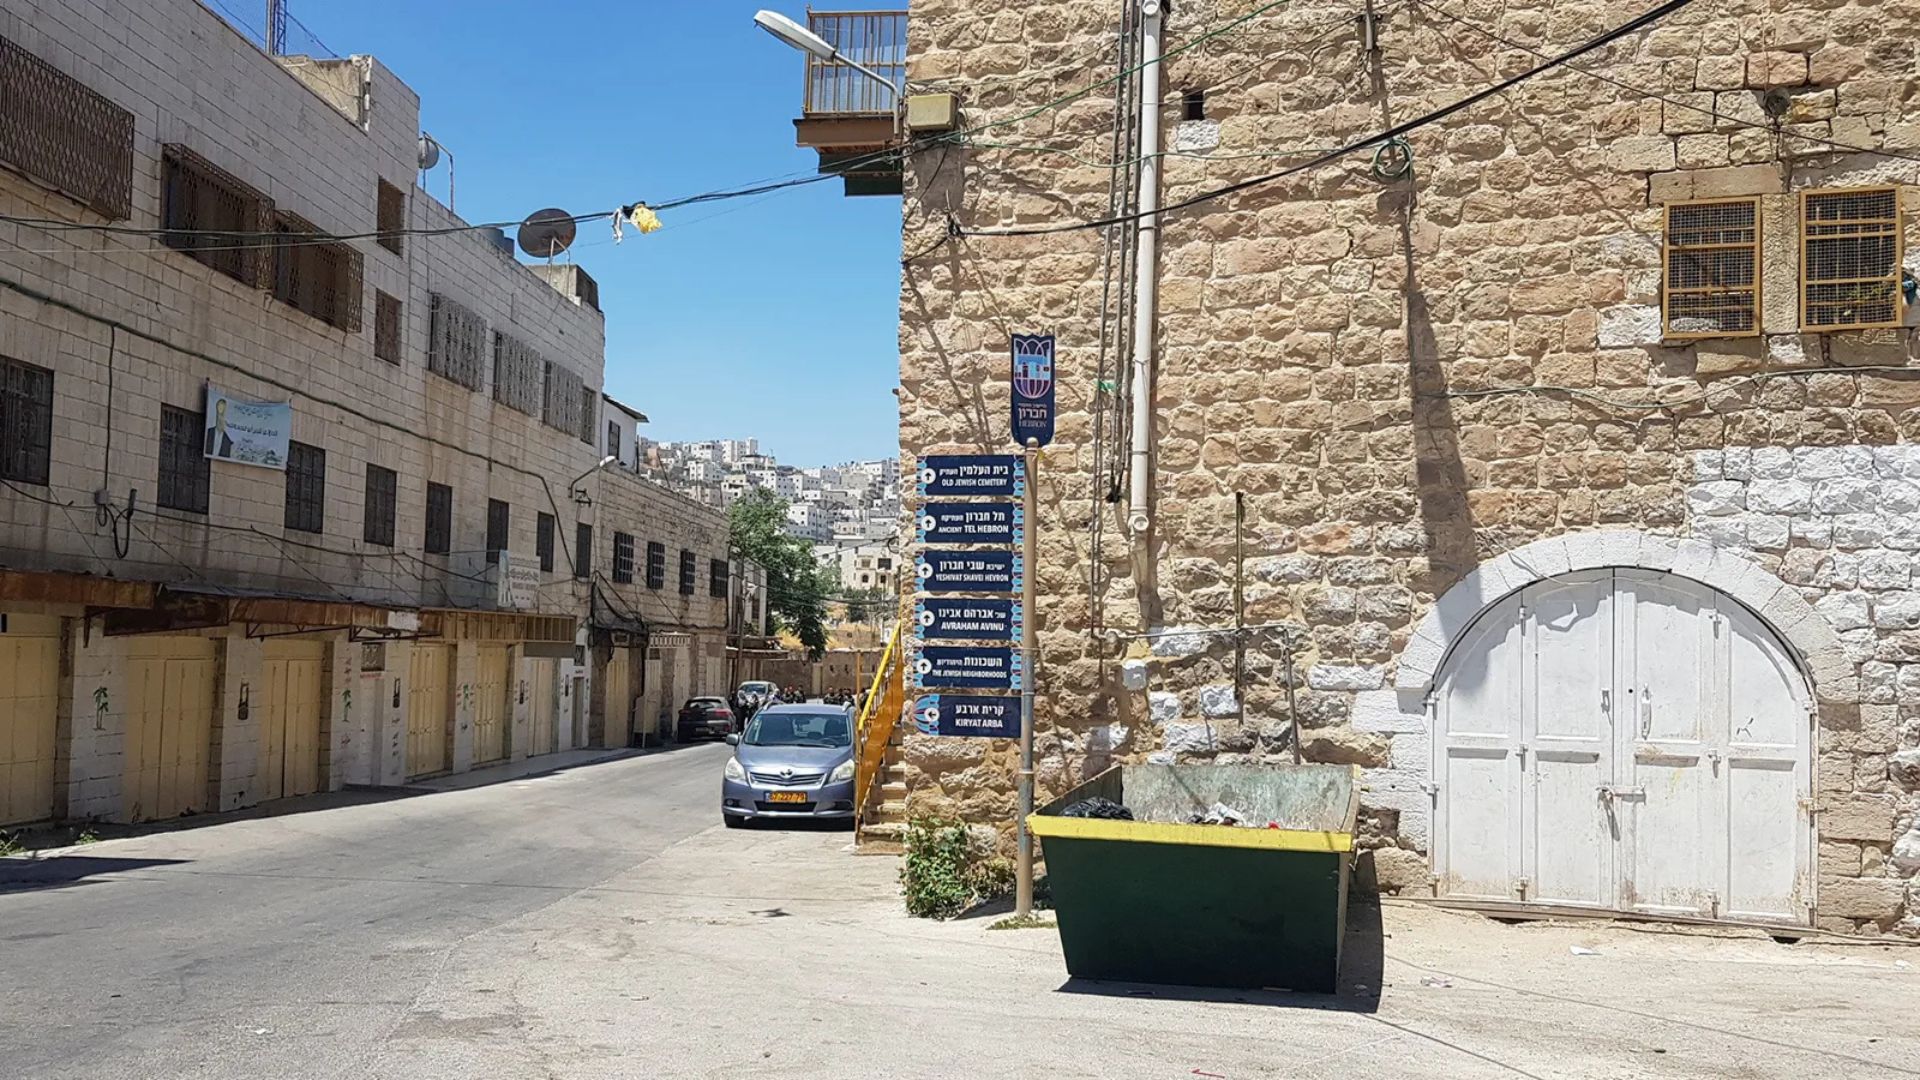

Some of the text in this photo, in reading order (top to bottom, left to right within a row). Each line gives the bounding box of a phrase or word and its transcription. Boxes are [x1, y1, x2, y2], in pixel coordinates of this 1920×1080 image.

[1018, 408, 1047, 420] חברון
[960, 464, 990, 476] העלמין
[993, 466, 1008, 475] בית
[955, 478, 976, 486] JEWISH
[978, 478, 1008, 486] CEMETERY
[965, 512, 990, 523] חברון
[992, 511, 1005, 521] תל
[964, 525, 976, 533] TEL
[977, 525, 1008, 533] HEBRON
[940, 561, 964, 572] חברון
[967, 561, 985, 570] שבי
[938, 608, 961, 618] אבינו
[964, 609, 994, 618] אברהם
[941, 622, 1004, 631] AVRAHAM AVINU
[964, 657, 1003, 667] השכונות
[955, 705, 1004, 716] קרית ארבע
[955, 719, 1003, 728] KIRYAT ARBA
